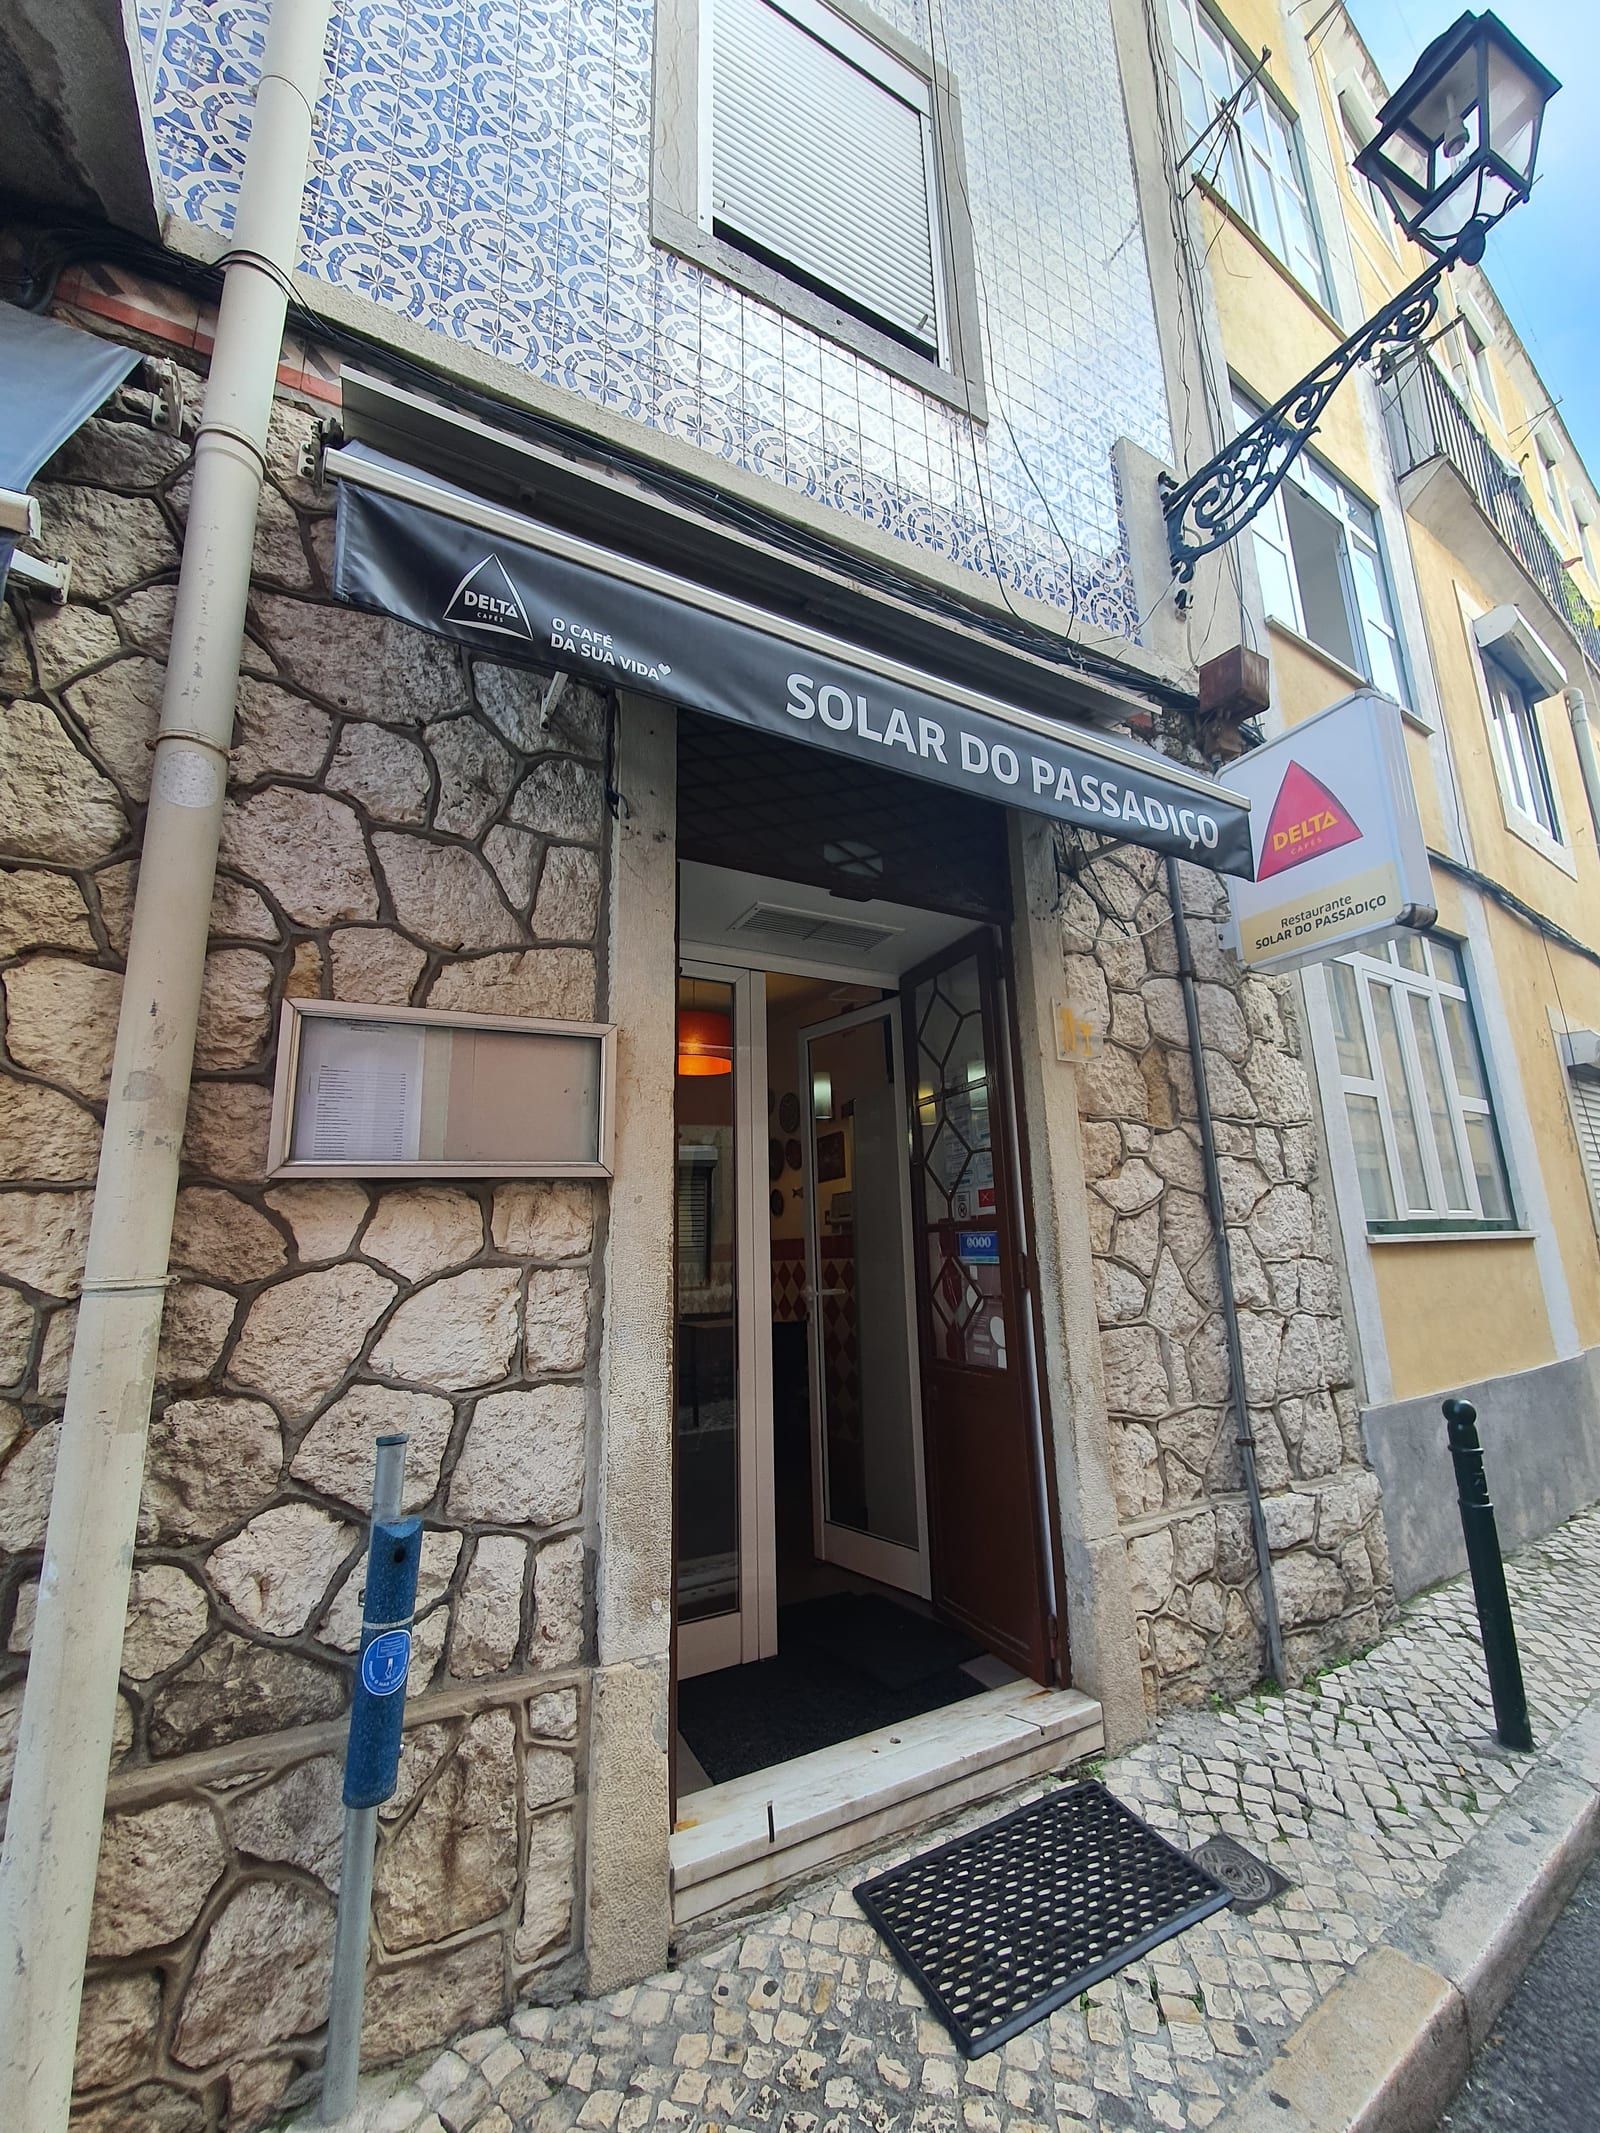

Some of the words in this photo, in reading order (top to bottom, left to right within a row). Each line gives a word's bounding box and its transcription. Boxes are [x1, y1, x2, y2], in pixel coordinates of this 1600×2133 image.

[463, 590, 519, 619] DELTA
[551, 616, 566, 632] O
[570, 624, 614, 650] CAFÉ
[550, 633, 576, 653] DA
[580, 643, 615, 666] SUA
[619, 655, 660, 681] VIDA
[785, 672, 949, 764] SOLAR
[960, 731, 1020, 786] DO
[1031, 755, 1219, 850] PASSADIÇO
[1272, 810, 1339, 852] DELTA
[1255, 929, 1292, 950] SOLAR
[1295, 921, 1312, 936] DO
[1315, 895, 1387, 930] PASSADIÇO
[1280, 895, 1352, 929] Restaurante
